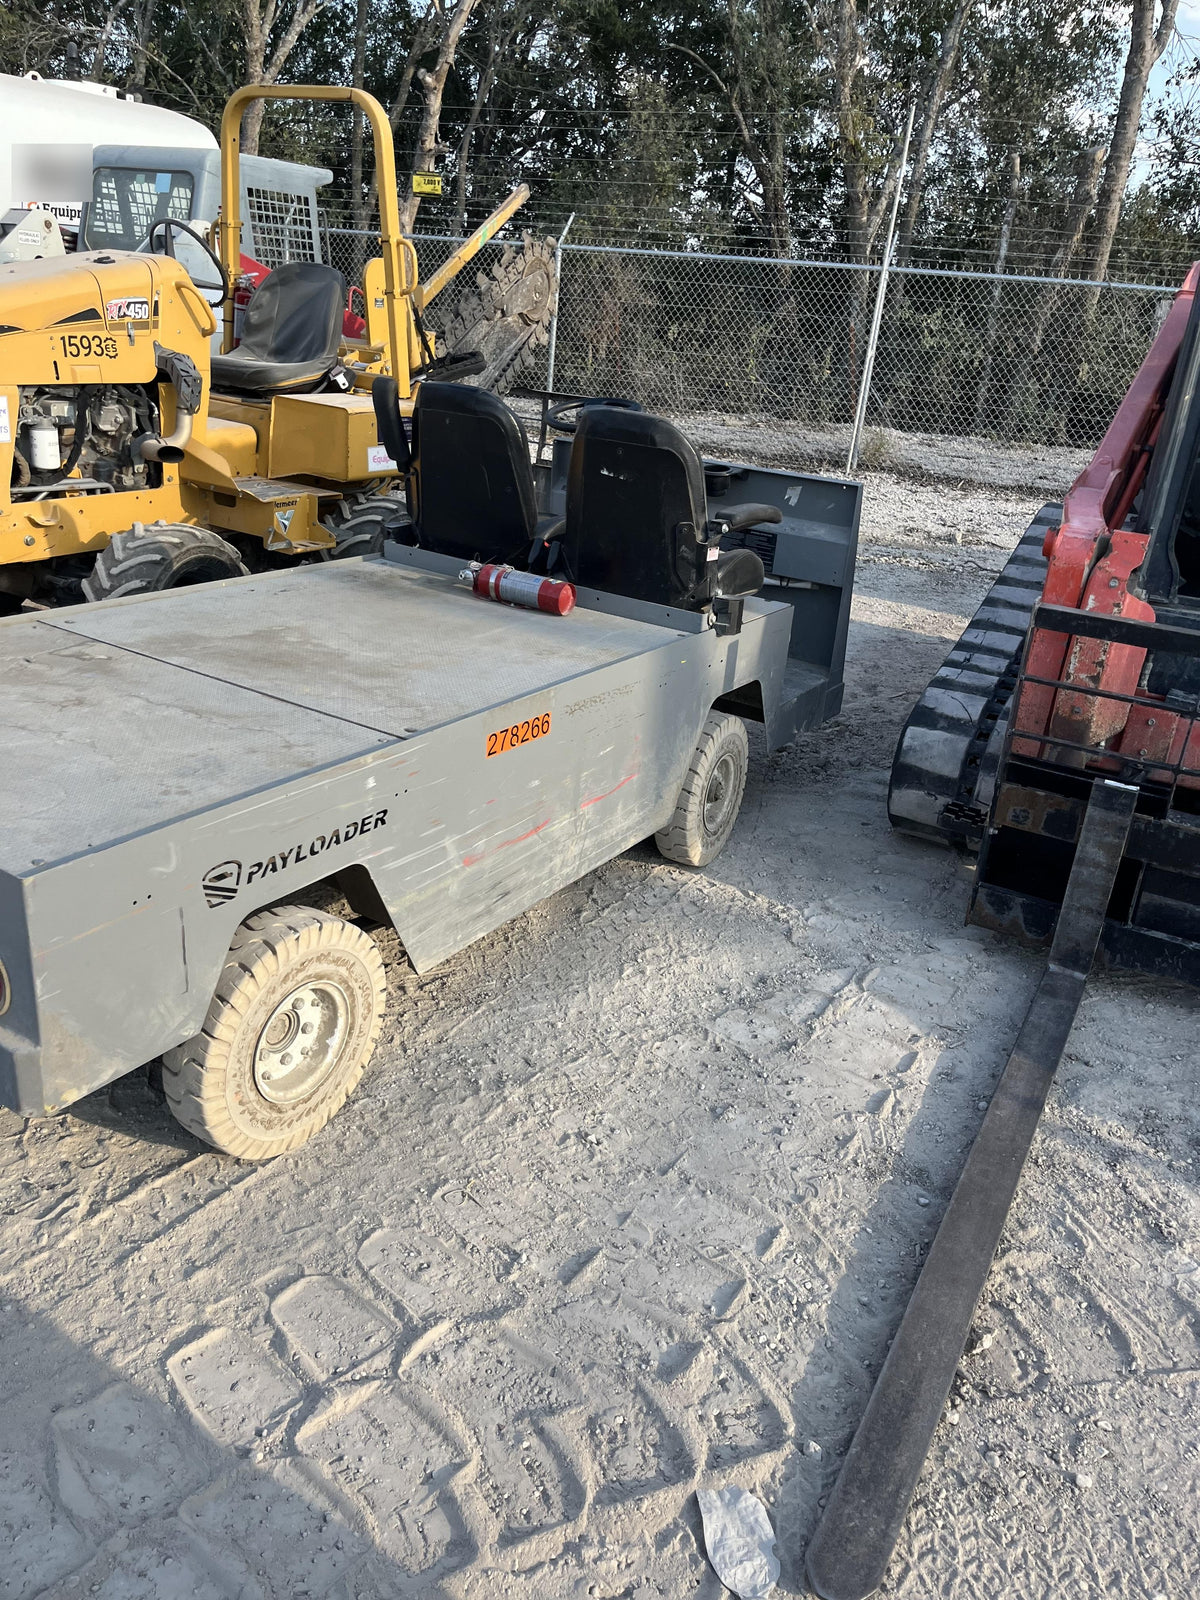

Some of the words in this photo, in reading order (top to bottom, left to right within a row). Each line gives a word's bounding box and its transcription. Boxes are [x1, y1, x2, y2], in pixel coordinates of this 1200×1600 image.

[60, 335, 104, 358] 1593
[487, 712, 551, 757] 278266
[246, 808, 389, 885] PAYLOADER
